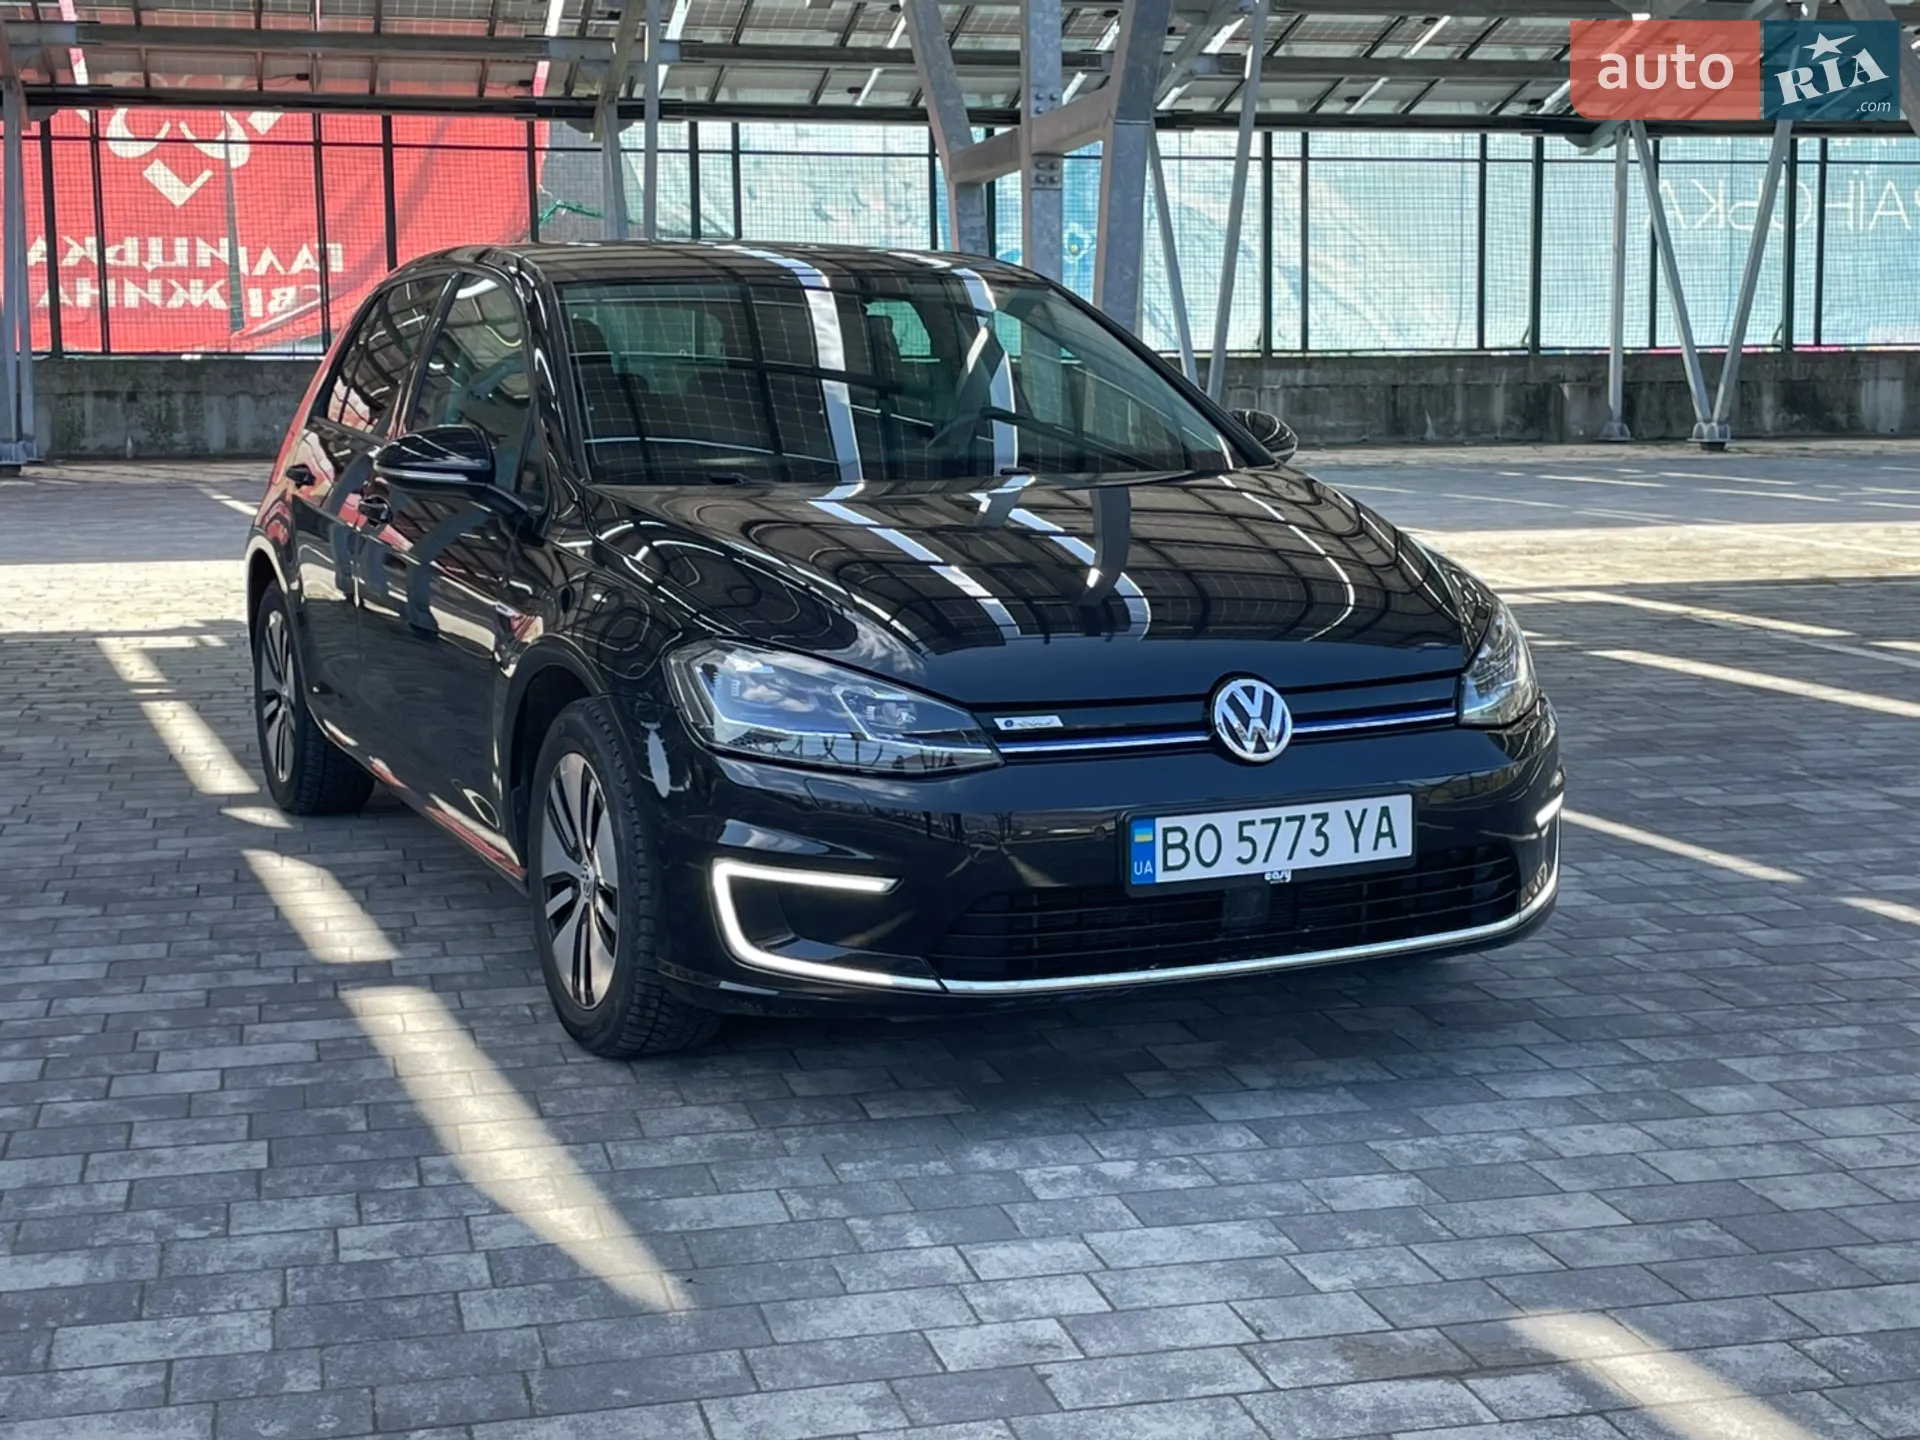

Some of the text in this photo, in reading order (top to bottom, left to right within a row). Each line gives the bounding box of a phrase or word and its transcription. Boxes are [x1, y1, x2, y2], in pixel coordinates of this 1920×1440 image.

[1162, 805, 1397, 872] BO 5773 YA
[1133, 860, 1154, 876] UA
